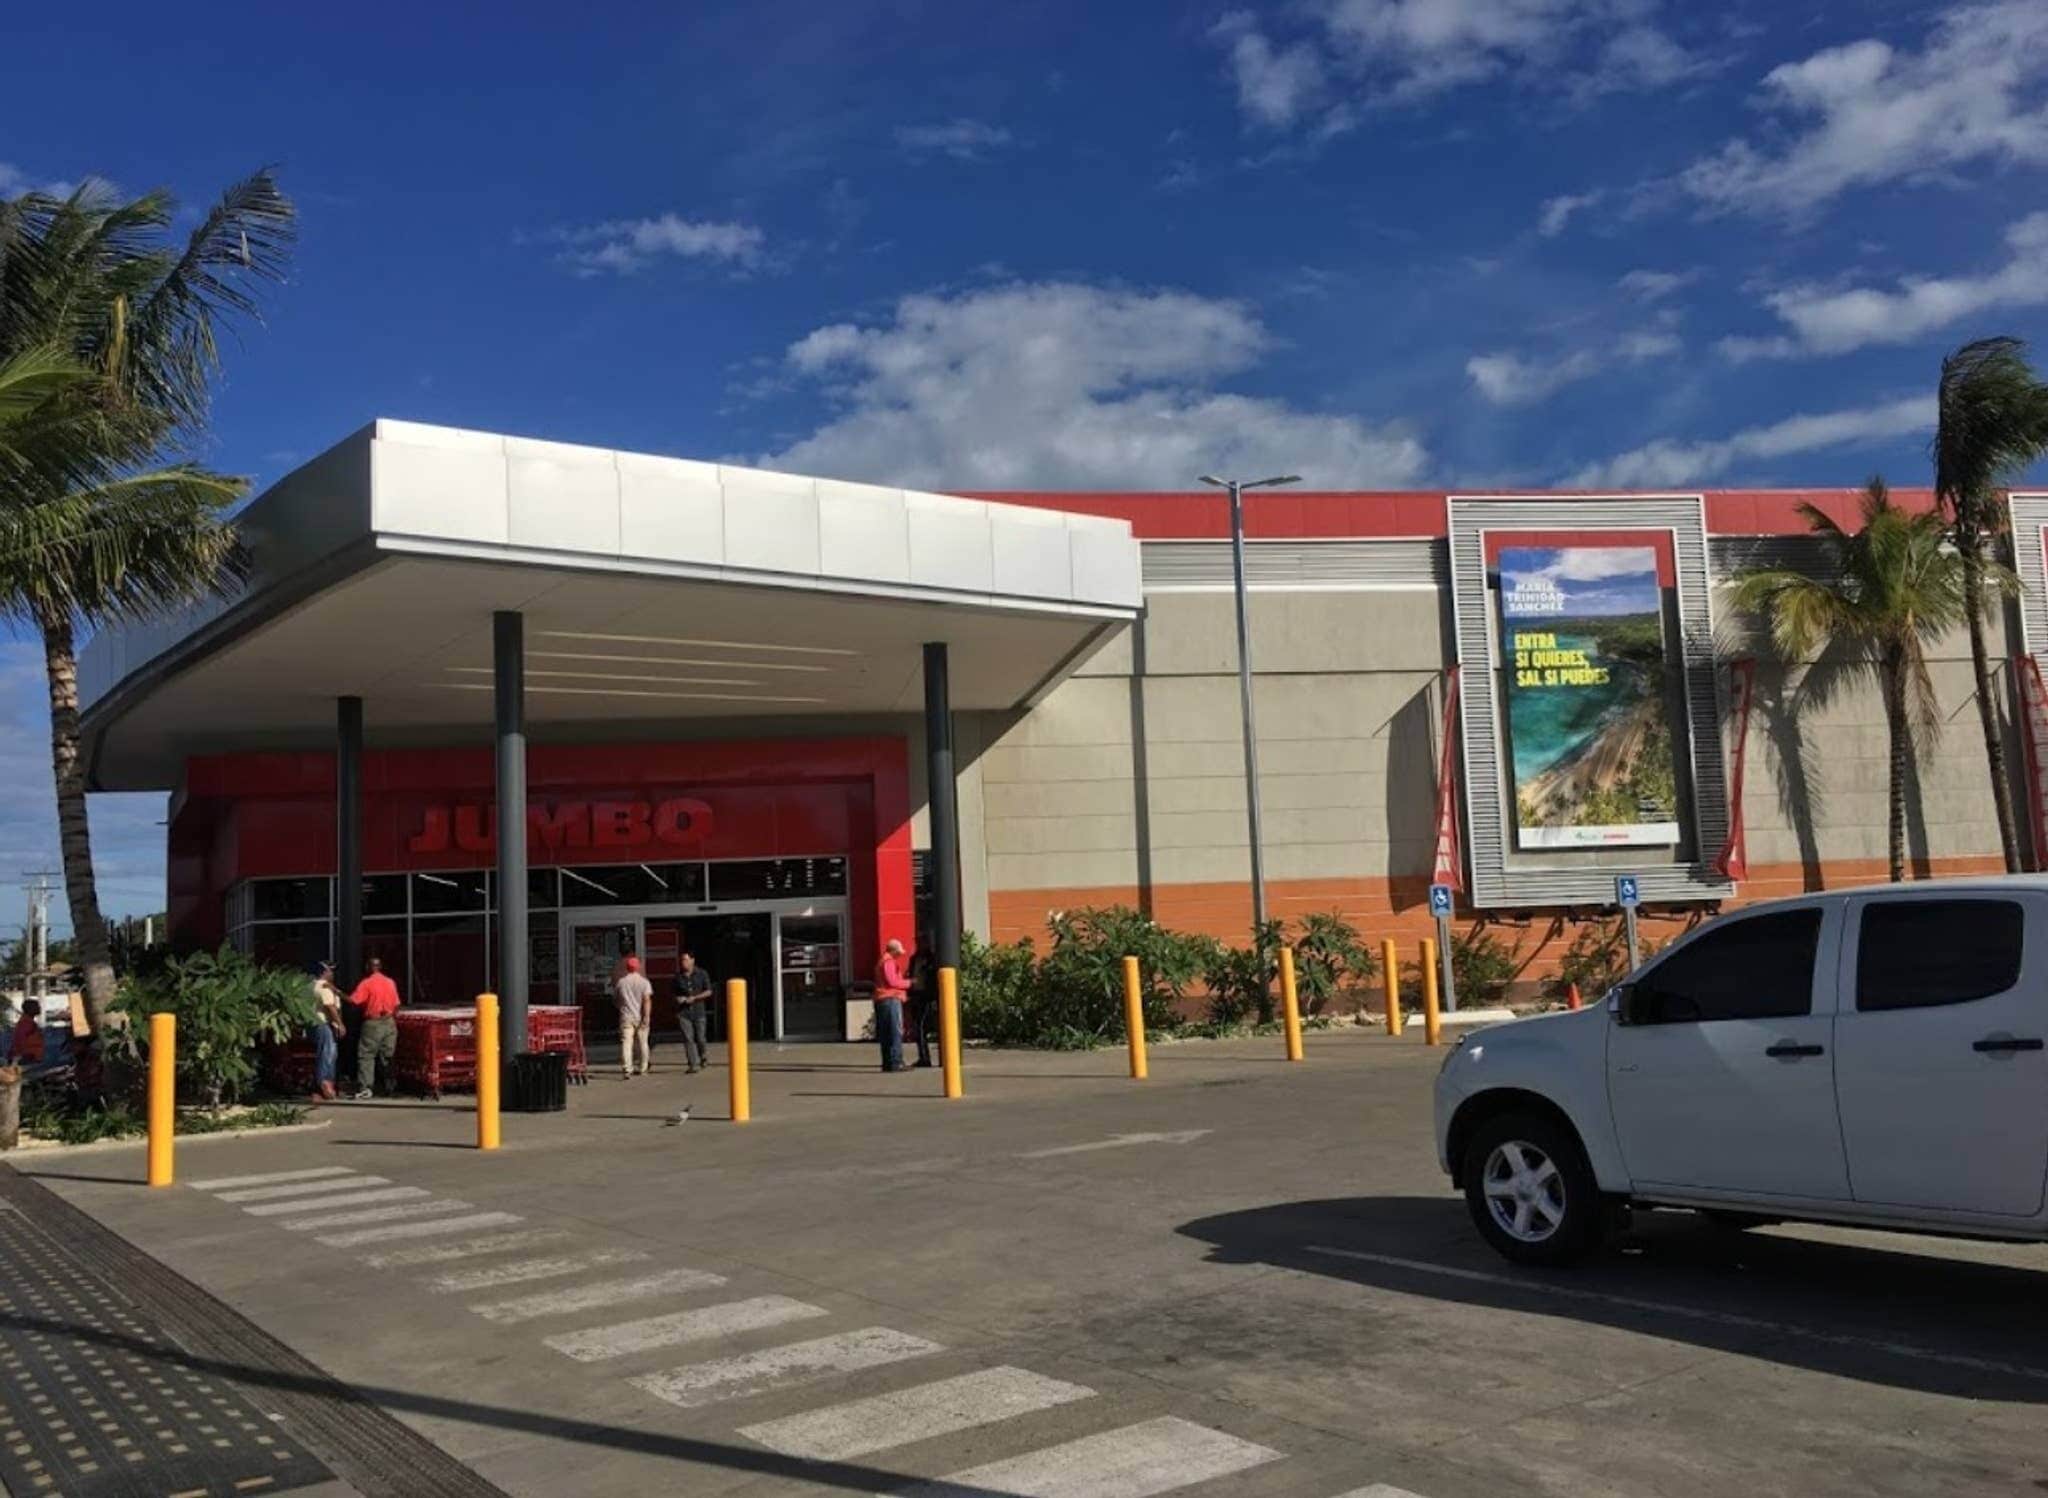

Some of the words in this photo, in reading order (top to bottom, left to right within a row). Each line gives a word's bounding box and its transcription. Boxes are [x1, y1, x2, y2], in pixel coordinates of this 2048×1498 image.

[1506, 592, 1565, 602] TRINIDAD
[1514, 633, 1556, 649] ENTRA
[1515, 651, 1530, 668] SI
[1532, 650, 1590, 669] QUIERES,
[1516, 670, 1543, 687] SAL
[1544, 669, 1559, 686] SI
[1560, 668, 1611, 686] PUEDES
[409, 798, 713, 852] JUMBO
